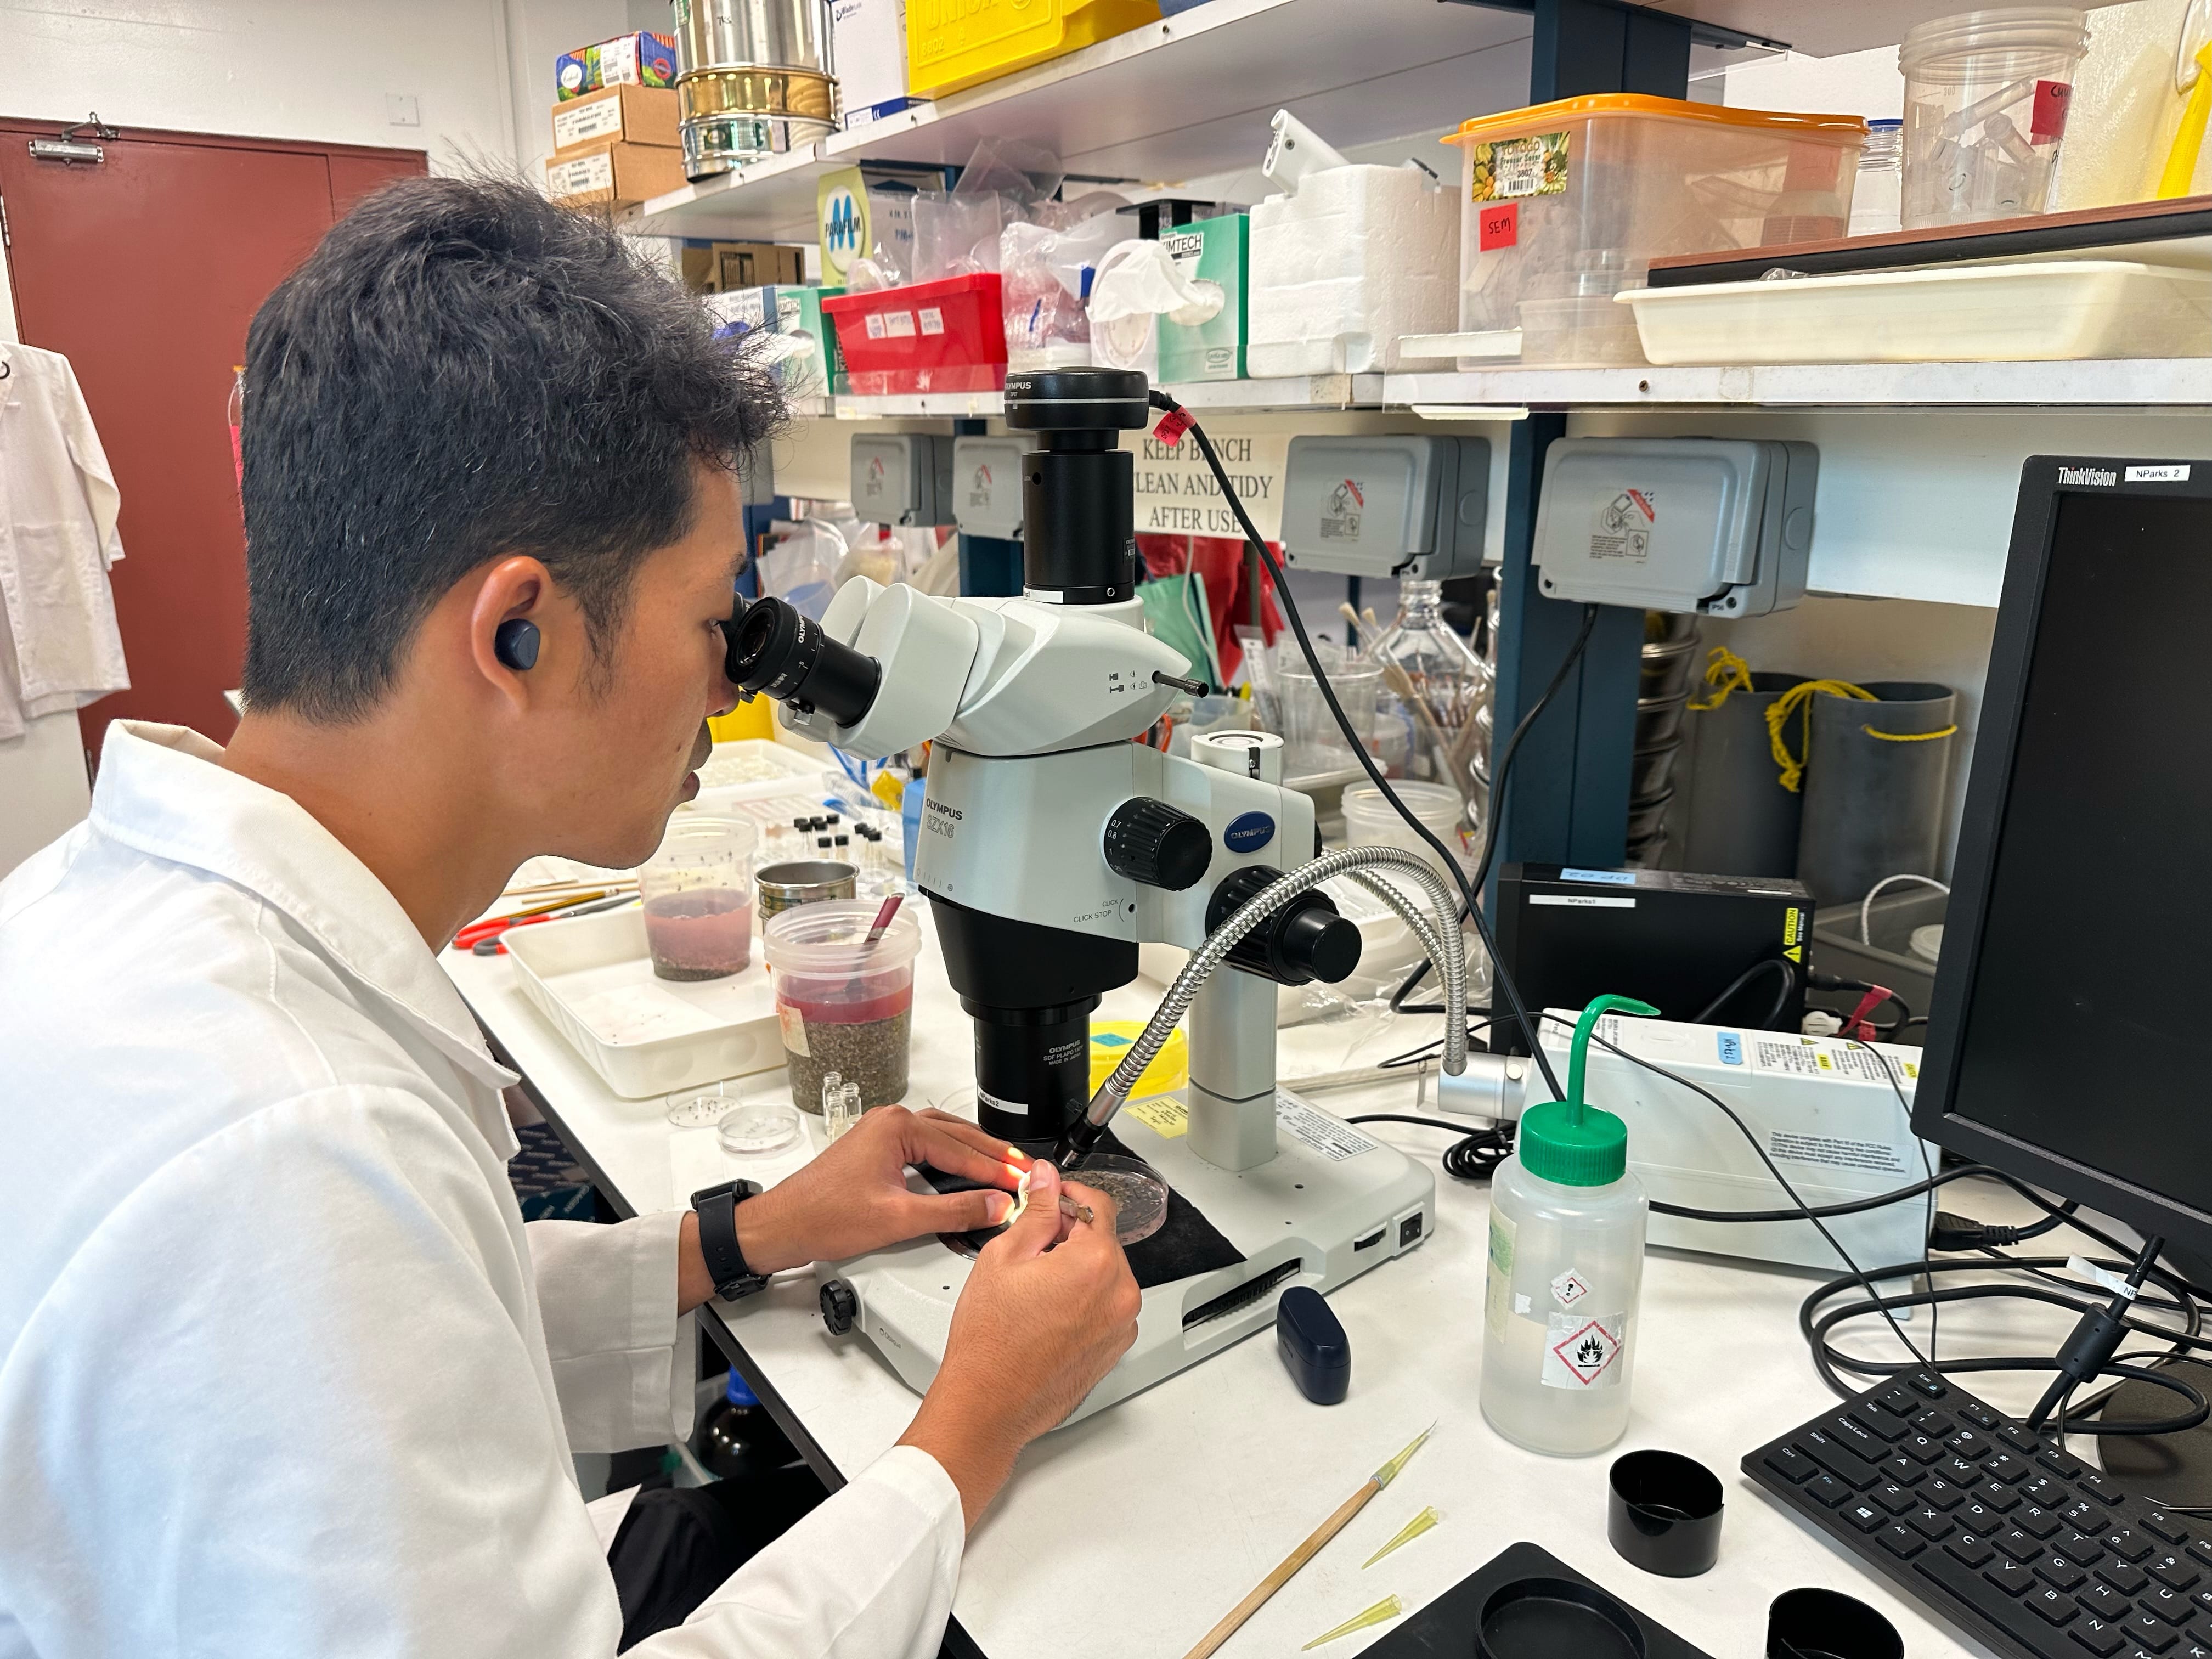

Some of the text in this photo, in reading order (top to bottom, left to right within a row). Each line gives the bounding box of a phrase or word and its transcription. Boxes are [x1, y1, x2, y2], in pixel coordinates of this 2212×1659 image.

[1502, 141, 1541, 155] TOYOGO
[825, 217, 861, 238] PARAFILM
[1489, 217, 1511, 234] SEM
[1143, 438, 1251, 461] KEEP BNCH
[2058, 467, 2117, 487] ThinkVision
[2136, 469, 2180, 478] NParks 2
[1135, 472, 1179, 494] LEAN
[1184, 474, 1222, 496] AND
[1149, 506, 1243, 533] AFTER USE
[926, 798, 962, 820] OLYMPUS
[927, 814, 955, 838] SZX16
[1111, 820, 1121, 828] 0.7
[1108, 830, 1117, 839] 0.8
[1231, 826, 1270, 839] OLYMPUS
[1074, 910, 1112, 923] CLICK STOP
[1786, 909, 1796, 944] CAUTION
[1049, 1040, 1081, 1053] OLYMPUS
[1056, 1049, 1074, 1059] PLAPO
[980, 1092, 1000, 1107] NParks2
[1918, 1374, 1931, 1383] Esc
[1866, 1402, 1878, 1412] Tab
[1838, 1417, 1869, 1440] Caps Lock
[2008, 1426, 2019, 1435] F2
[1810, 1432, 1826, 1444] Shift
[1961, 1431, 1973, 1440] @
[1917, 1437, 1927, 1445] Q
[1782, 1448, 1795, 1458] Ctrl
[2048, 1450, 2059, 1458] F3
[1897, 1458, 1907, 1466] A
[1954, 1459, 1970, 1470] W
[1822, 1476, 1832, 1485] Fn
[2090, 1475, 2101, 1483] F4
[1886, 1485, 1900, 1493] Z
[1990, 1482, 2002, 1491] E
[1971, 1505, 1983, 1514] D
[2078, 1503, 2090, 1511] %
[1923, 1509, 1936, 1518] X
[2029, 1508, 2041, 1516] R
[2152, 1512, 2164, 1521] F5
[1894, 1525, 1906, 1534] Alt
[1963, 1536, 1975, 1544] C
[2073, 1533, 2084, 1541] T
[2199, 1540, 2211, 1549] F6
[2005, 1561, 2017, 1570] V
[2053, 1558, 2065, 1567] G
[2117, 1560, 2128, 1568] Y
[2165, 1557, 2176, 1565] &
[2045, 1590, 2057, 1600] B
[2096, 1585, 2110, 1596] H
[2159, 1589, 2173, 1599] U
[2202, 1593, 2212, 1601] 8
[2089, 1620, 2103, 1630] N
[2190, 1646, 2205, 1658] K
